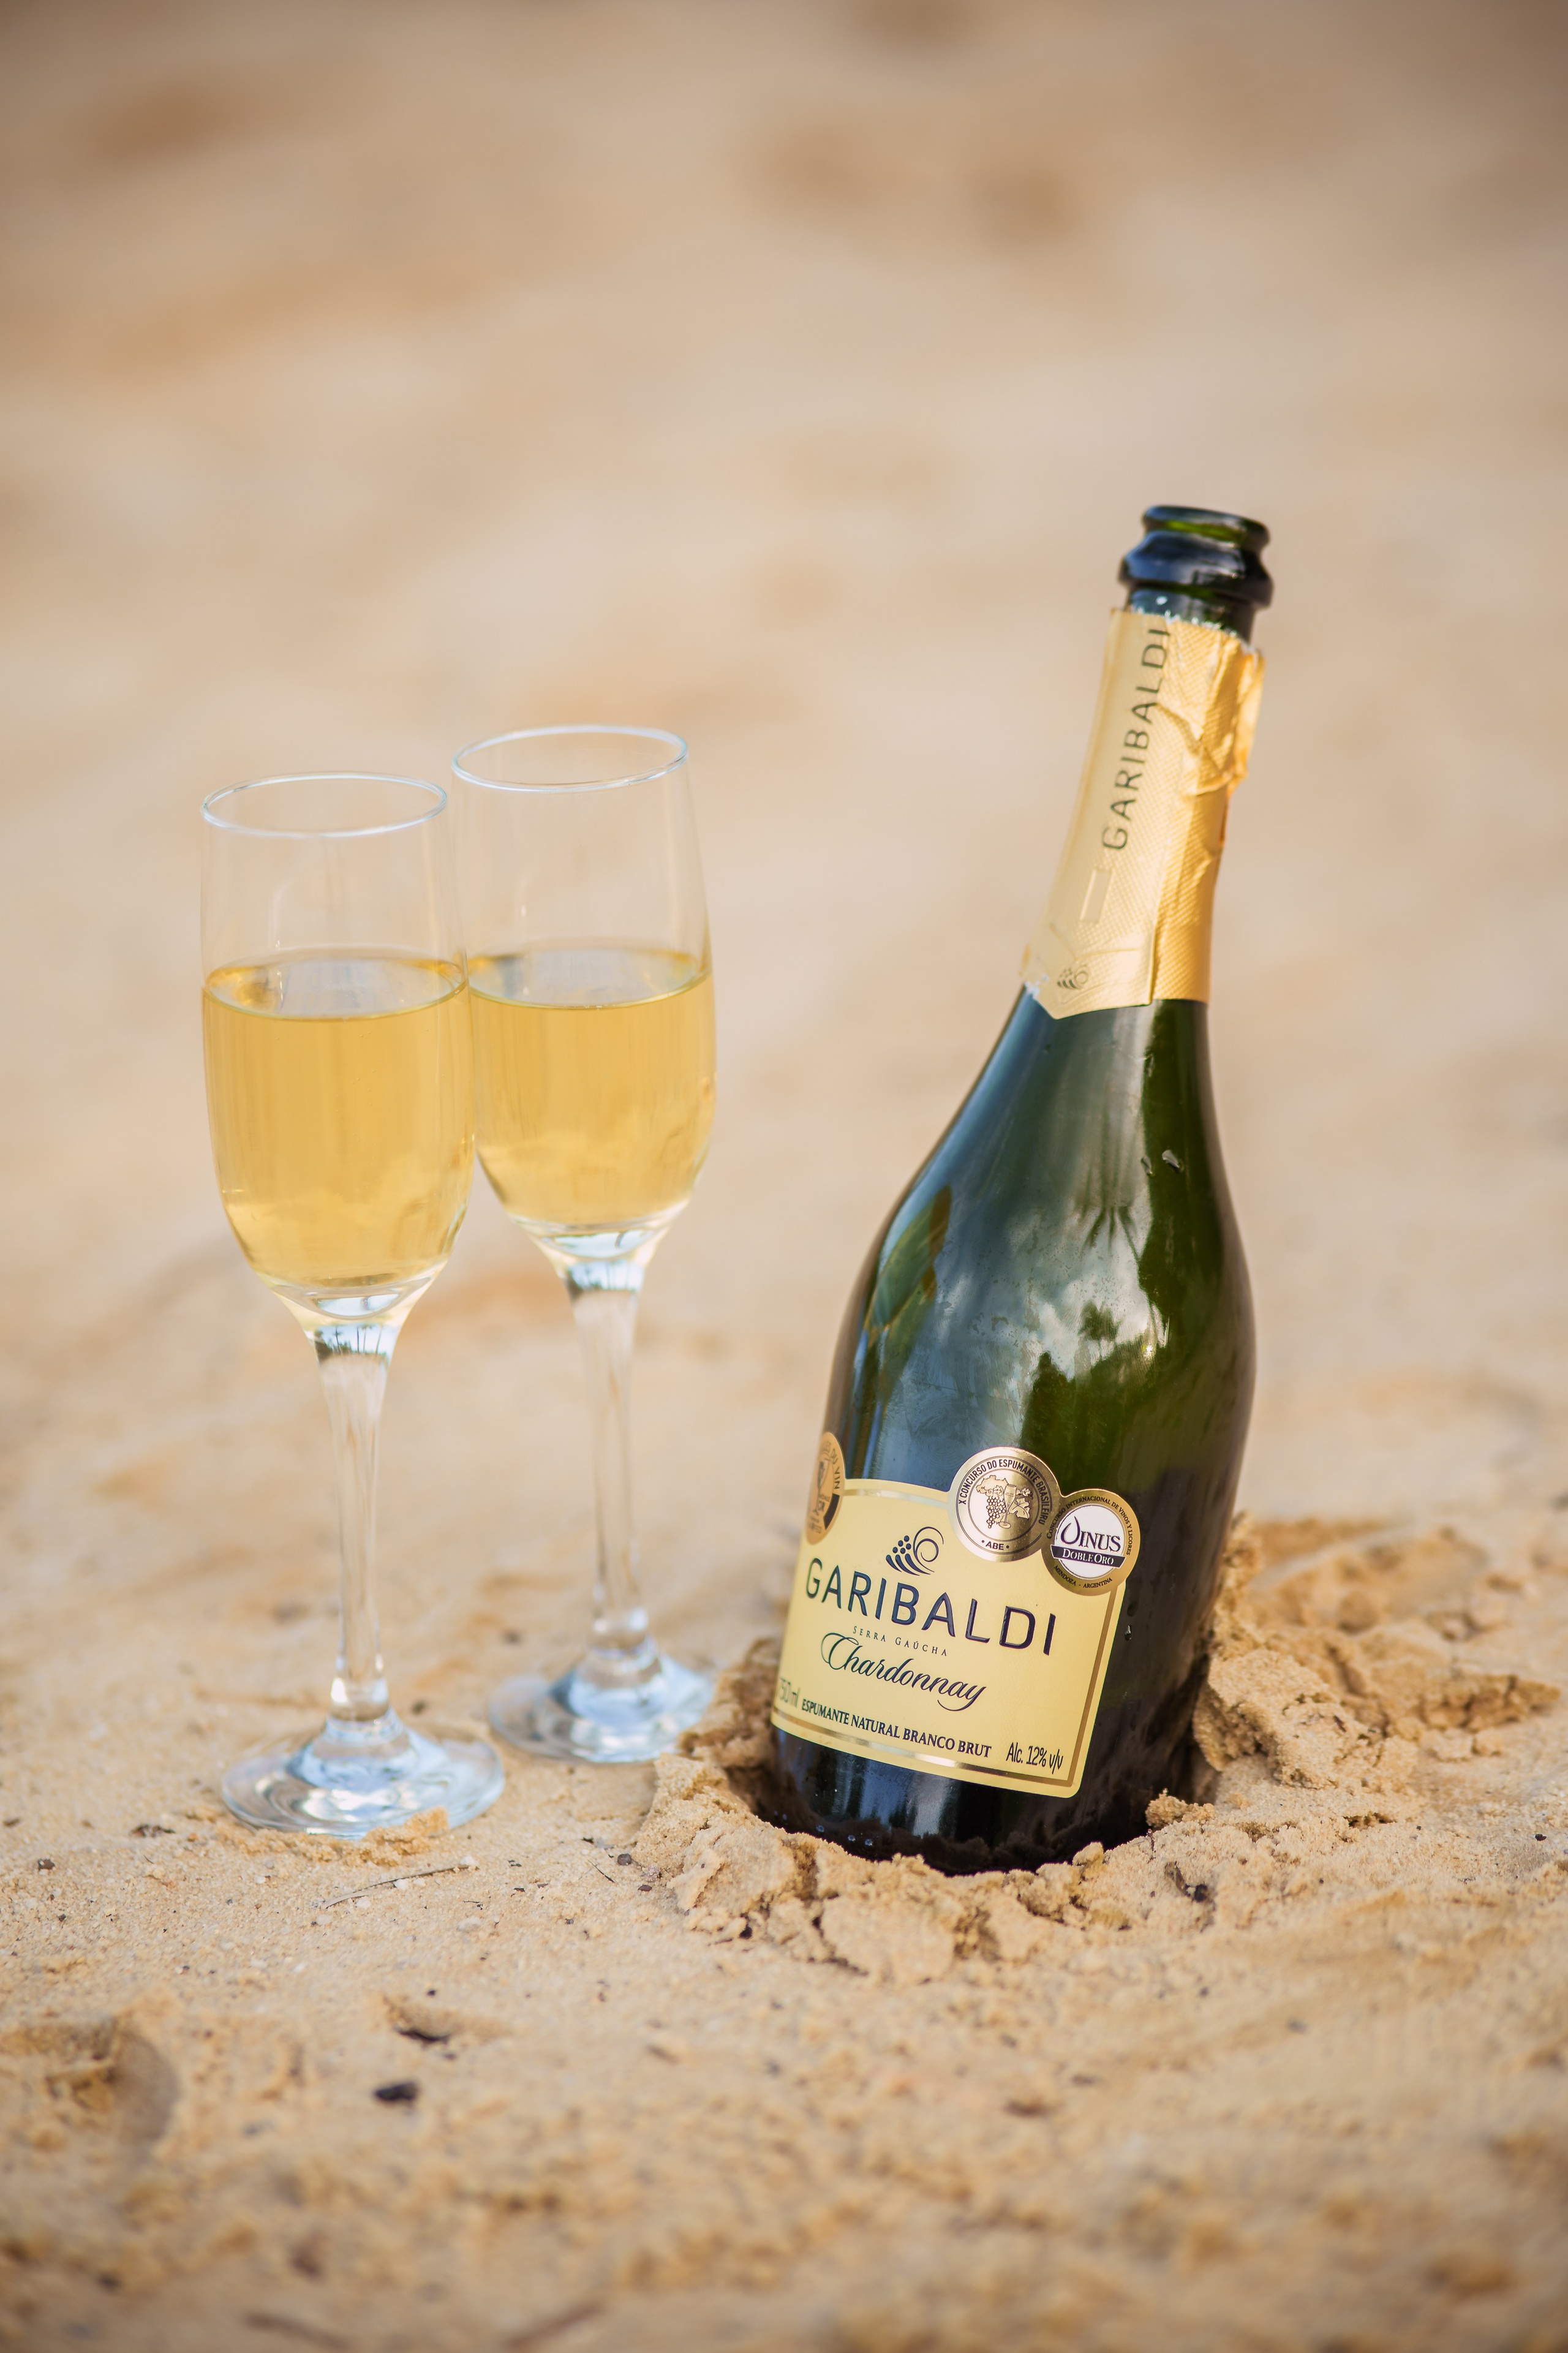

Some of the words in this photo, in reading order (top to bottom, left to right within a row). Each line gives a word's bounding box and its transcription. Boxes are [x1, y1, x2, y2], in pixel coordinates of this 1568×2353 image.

[1102, 629, 1171, 850] GARIBALDI
[960, 1464, 987, 1498] CONCURSO
[987, 1460, 997, 1469] DO
[999, 1459, 1041, 1482] ESPUMANTE
[1046, 1507, 1066, 1539] CONCURSO
[1066, 1496, 1111, 1509] INTERNACIONAL
[1119, 1508, 1130, 1524] VINOS
[986, 1541, 1004, 1550] ABE
[1094, 1554, 1114, 1565] ORO
[1054, 1565, 1076, 1586] MENDOZA
[1084, 1577, 1113, 1588] ARGENTINA
[805, 1558, 1056, 1656] GARIBALDI
[853, 1626, 886, 1642] SERRA
[895, 1637, 948, 1656] GAÚCHA
[821, 1632, 987, 1712] Chardonnay
[802, 1699, 850, 1725] ESPUMANTE
[851, 1715, 900, 1739] NATURAL
[903, 1728, 955, 1750] BRANCO
[957, 1740, 992, 1758] BRUT
[1006, 1742, 1023, 1764] Alc.
[1026, 1745, 1047, 1767] 12%
[1049, 1748, 1064, 1775] v/v
